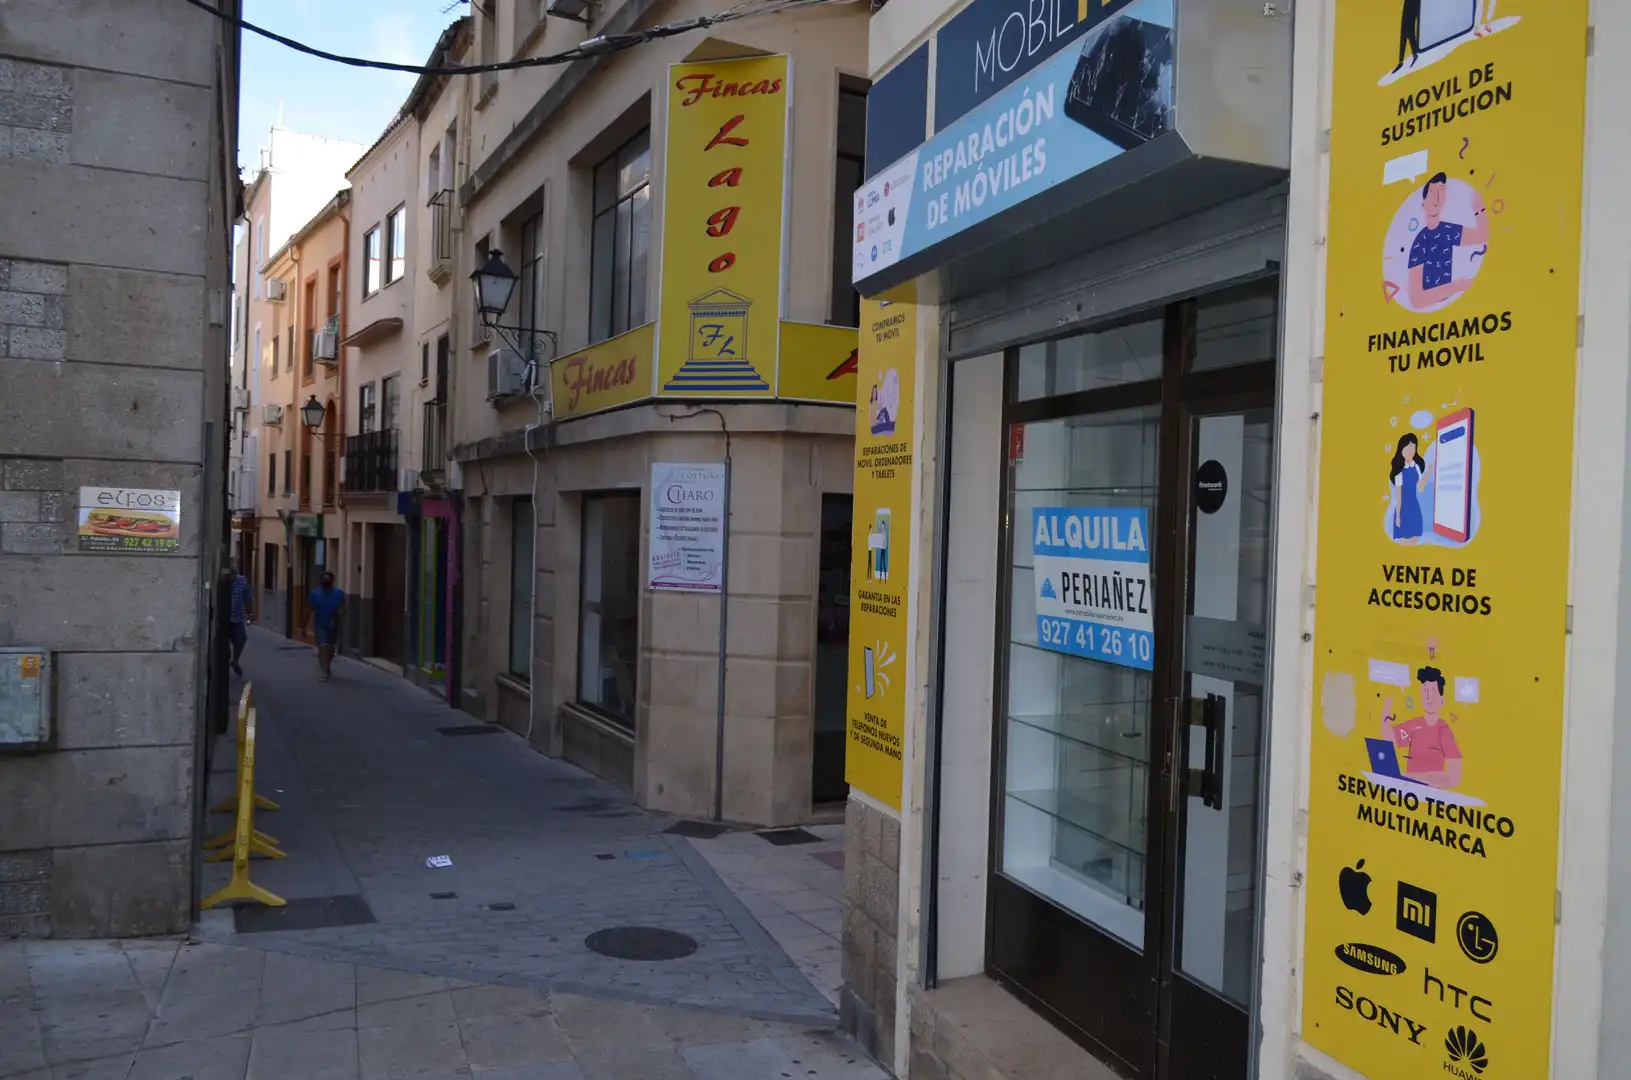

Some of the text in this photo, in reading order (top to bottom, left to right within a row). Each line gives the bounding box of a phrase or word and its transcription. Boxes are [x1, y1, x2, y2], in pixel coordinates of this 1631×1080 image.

[975, 0, 1111, 93] MOBIL
[676, 73, 782, 106] Fincas
[1397, 62, 1495, 116] MOVIL DE
[1381, 82, 1512, 145] SUSTITUCION
[923, 83, 1055, 192] REPARACIÓN
[927, 137, 1047, 230] DE MÓVILES
[872, 313, 906, 332] COMPRAMOS
[876, 328, 899, 343] TU MOVIL
[1367, 311, 1513, 352] FINANCIAMOS
[1388, 343, 1485, 373] TU MOVIL
[565, 356, 636, 410] Fincas
[857, 455, 912, 468] MOVIL ORDENADORES
[863, 442, 907, 456] REPARACIONES DE
[876, 469, 895, 478] TABLETS
[124, 538, 139, 547] 927
[142, 539, 152, 548] 42
[1035, 515, 1146, 551] ALQUILA
[1382, 564, 1477, 588] VENTA DE
[858, 589, 901, 606] GARANTIA EN LAS
[1062, 570, 1148, 614] PERIAÑEZ
[1368, 588, 1492, 616] ACCESORIOS
[861, 602, 897, 618] REPARACIONES
[1041, 619, 1150, 661] 927 41 26 10
[852, 719, 900, 747] TELEFONOS NUEVOS
[864, 711, 887, 729] VENTA DE
[854, 731, 860, 742] DE
[860, 735, 884, 752] SEGUNDA
[885, 746, 902, 760] MANO
[1338, 774, 1515, 838] SERVICIO TECNICO
[1357, 804, 1487, 859] MULTIMARCA
[1343, 943, 1398, 976] SAMSUNG
[1335, 986, 1428, 1046] SONY
[1443, 1060, 1482, 1080] HUAW
